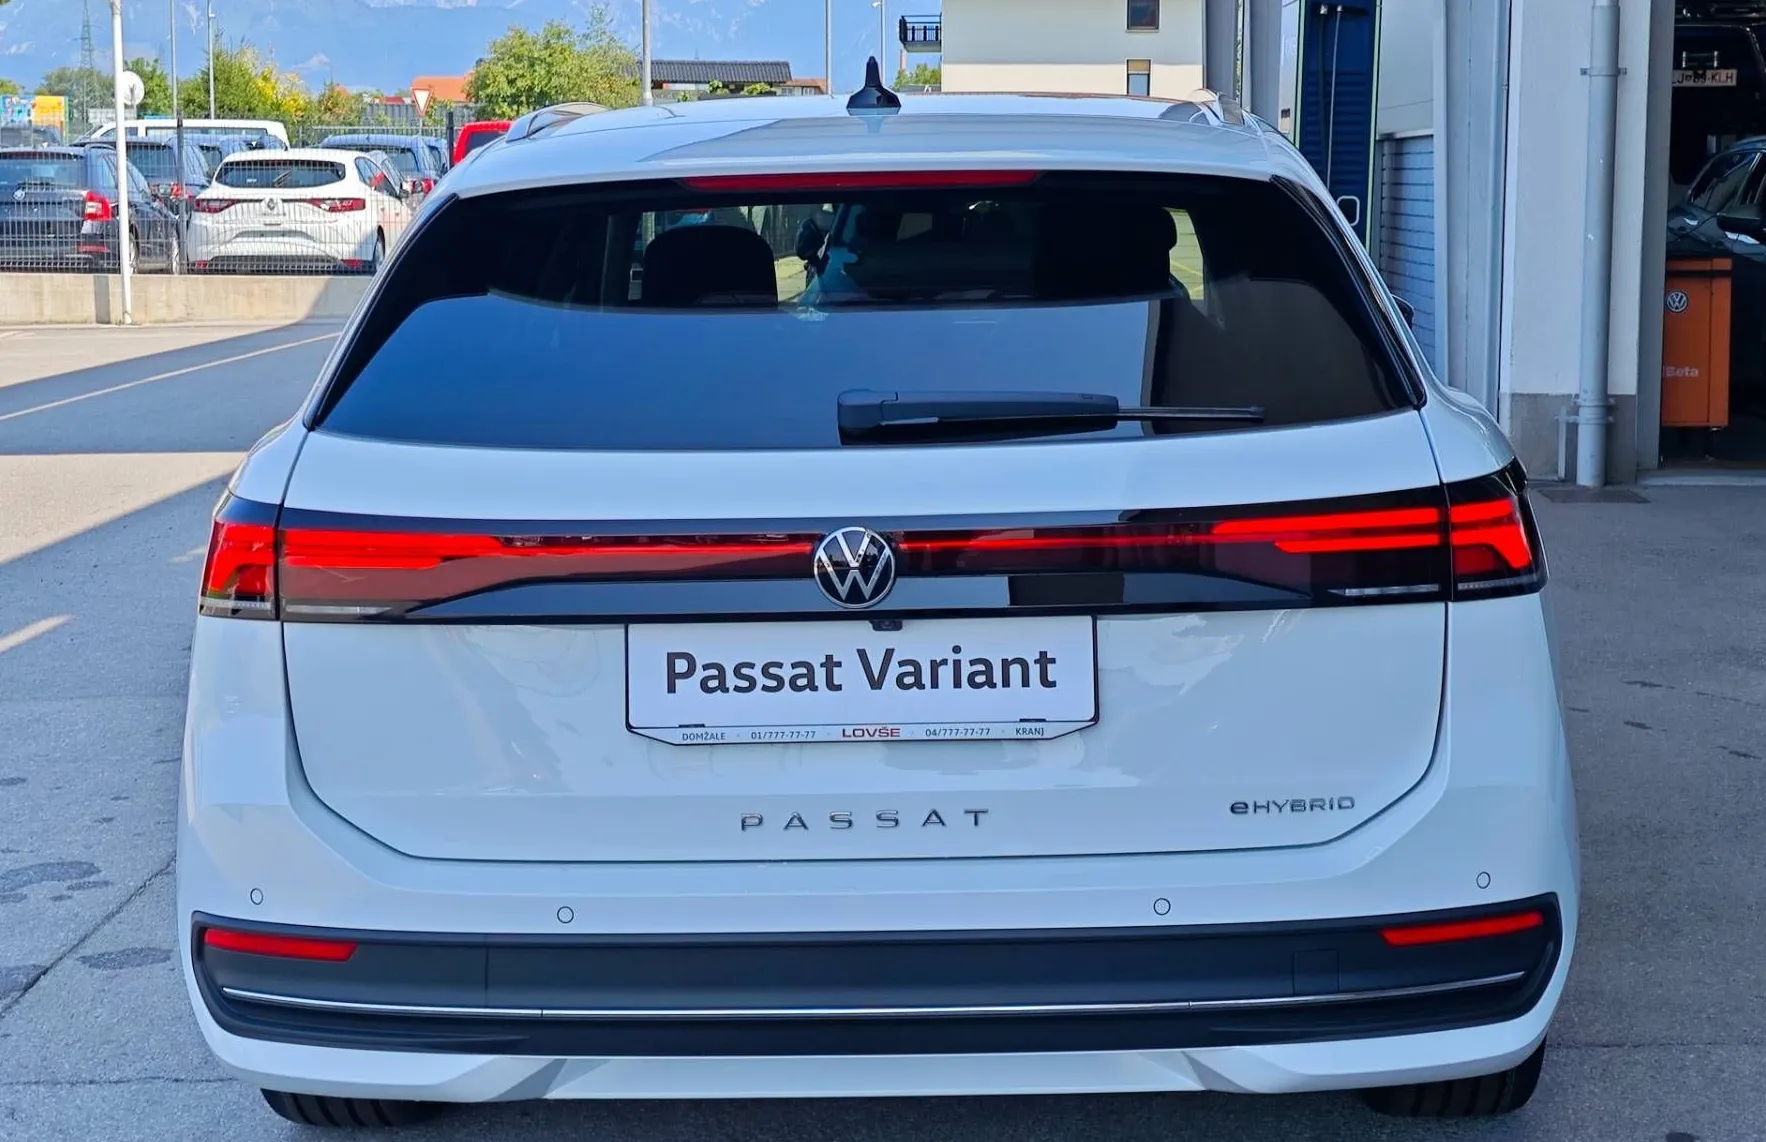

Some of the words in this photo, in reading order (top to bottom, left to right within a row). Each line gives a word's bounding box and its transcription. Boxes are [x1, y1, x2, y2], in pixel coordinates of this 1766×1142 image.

[815, 528, 893, 607] VW
[666, 651, 843, 694] Passat
[856, 644, 1058, 691] Variant
[682, 729, 726, 741] DOMŽALE
[751, 730, 816, 740] 01/777-77-77
[842, 725, 901, 738] LOVŠE
[925, 727, 991, 737] 04/777-77-77
[1015, 727, 1045, 737] KRANJ
[1229, 796, 1356, 814] eHYBRID
[741, 808, 989, 831] PASSAT
